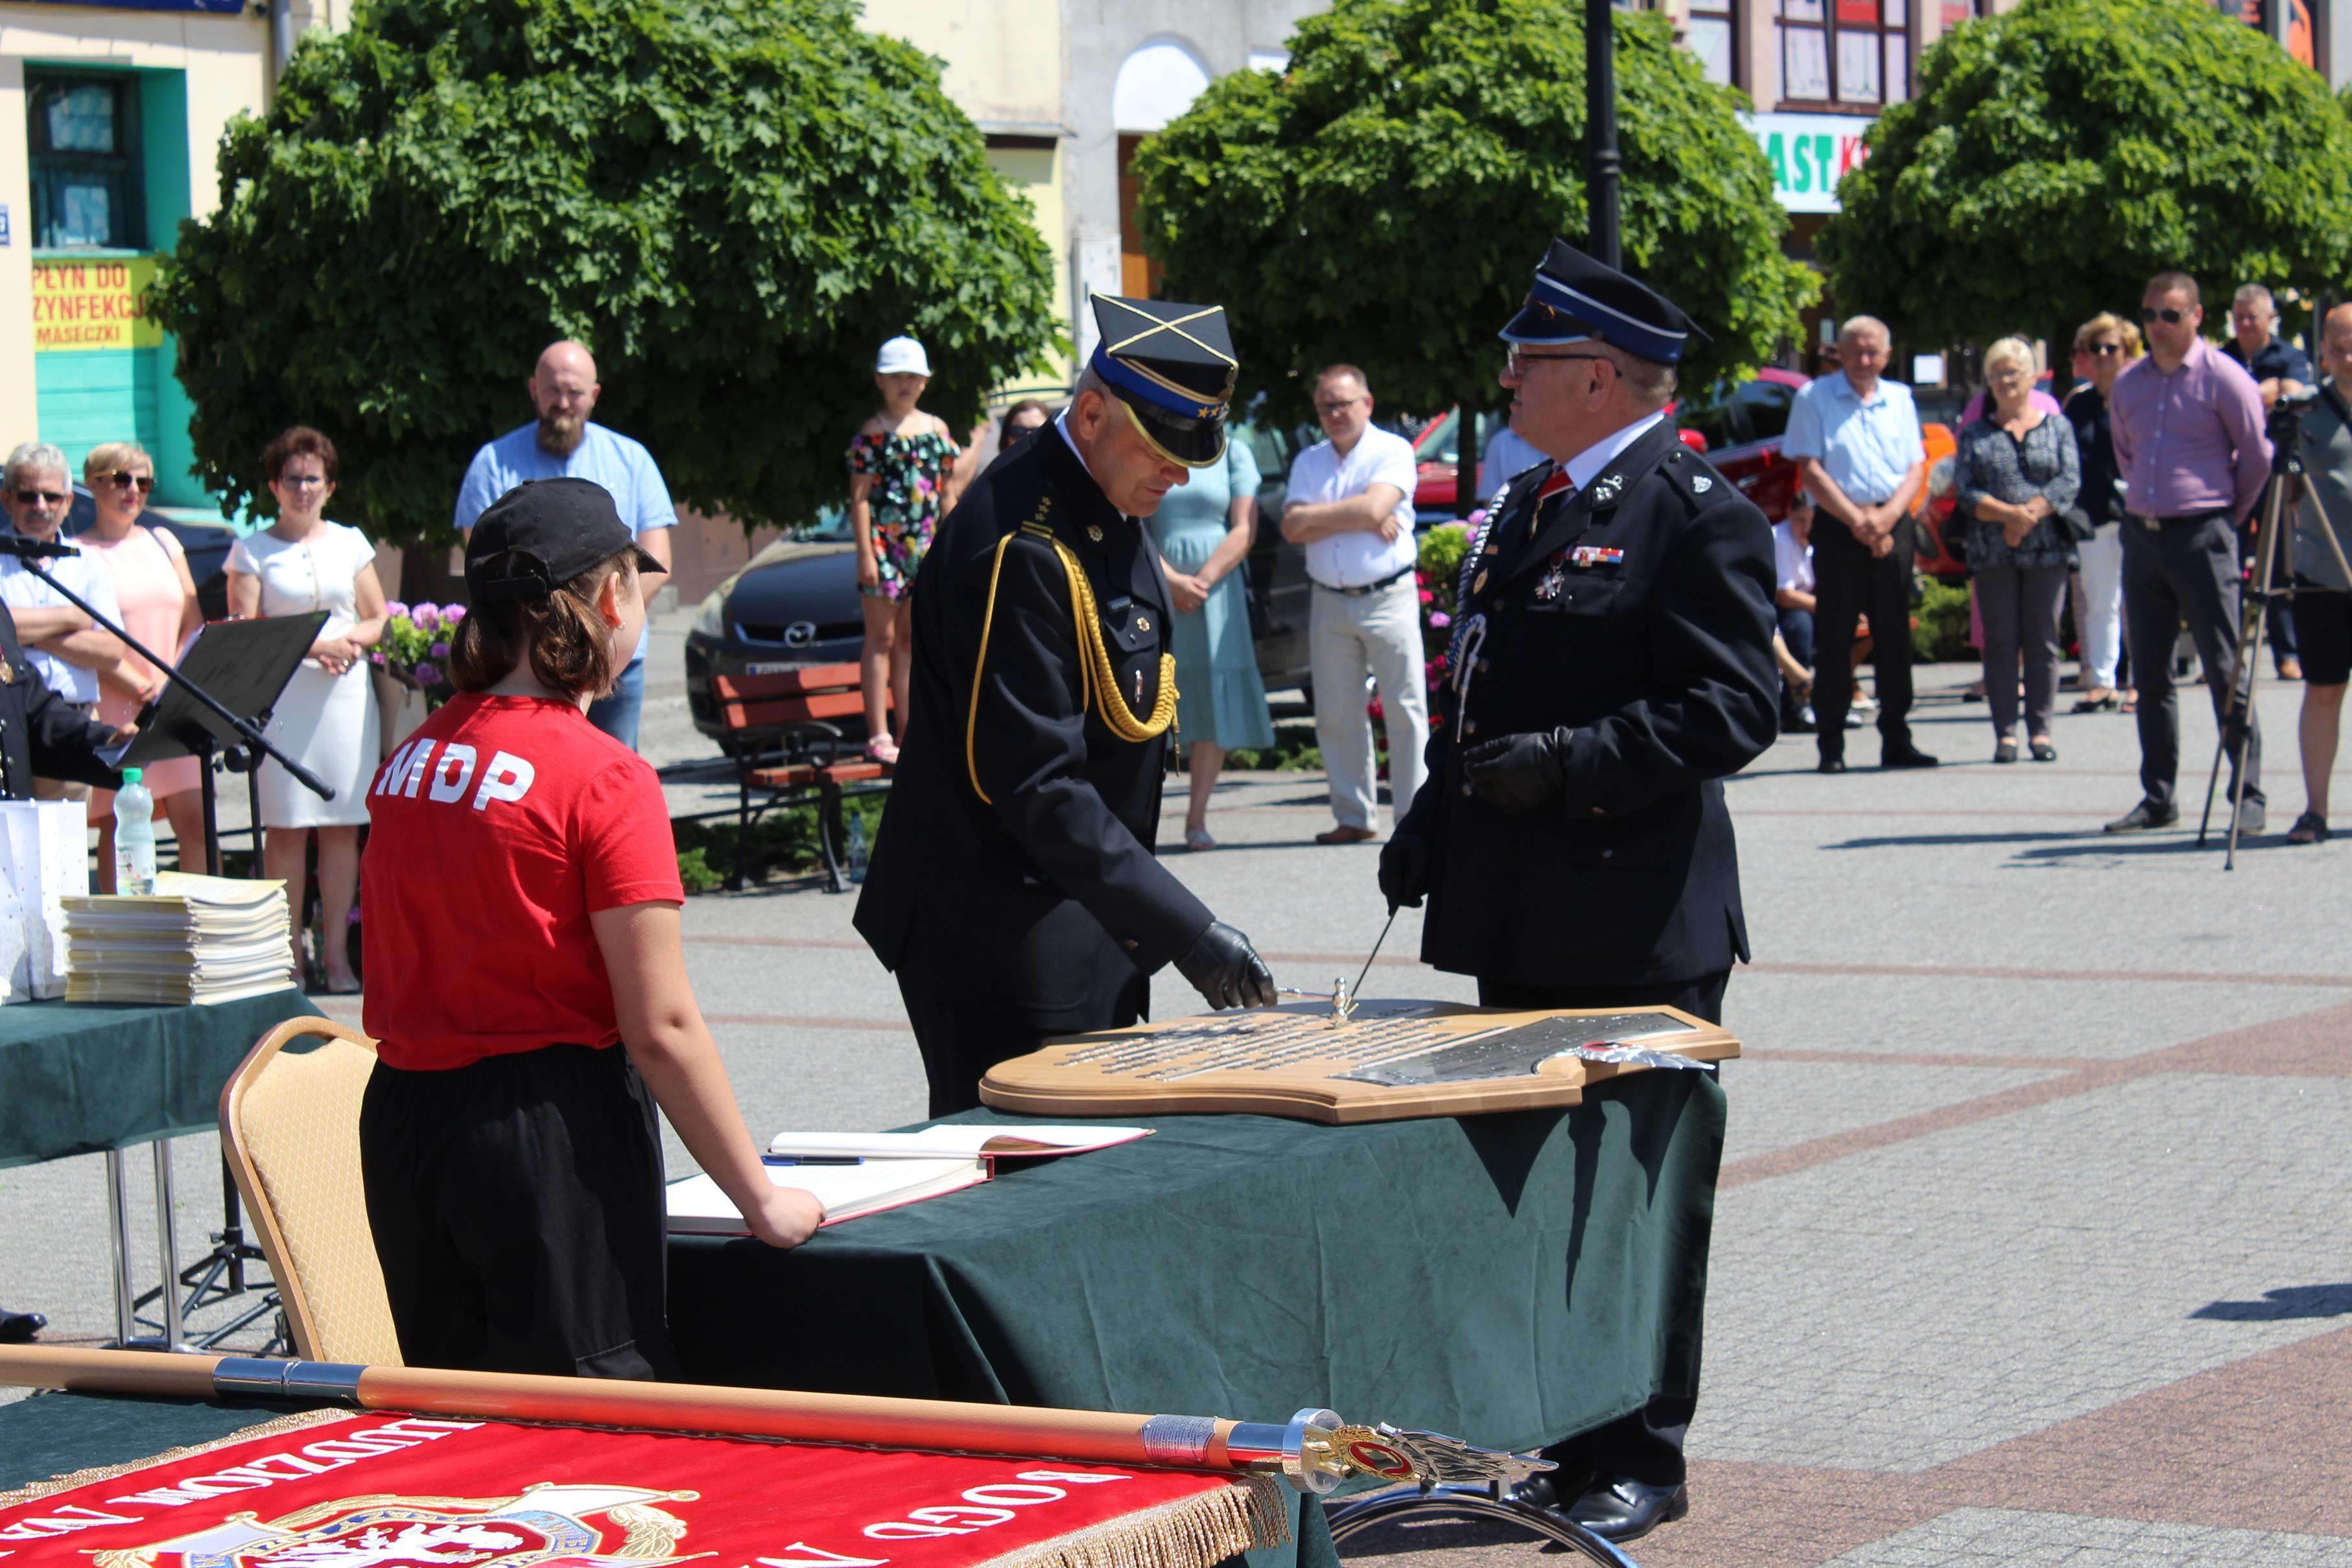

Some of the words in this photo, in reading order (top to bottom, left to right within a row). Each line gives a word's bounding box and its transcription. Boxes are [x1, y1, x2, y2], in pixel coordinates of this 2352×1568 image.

[97, 262, 125, 288] DO
[37, 326, 120, 344] MASECZKI
[375, 738, 535, 812] MDP
[104, 1418, 486, 1506] LUDZIOM
[862, 1469, 1133, 1539] BOGU
